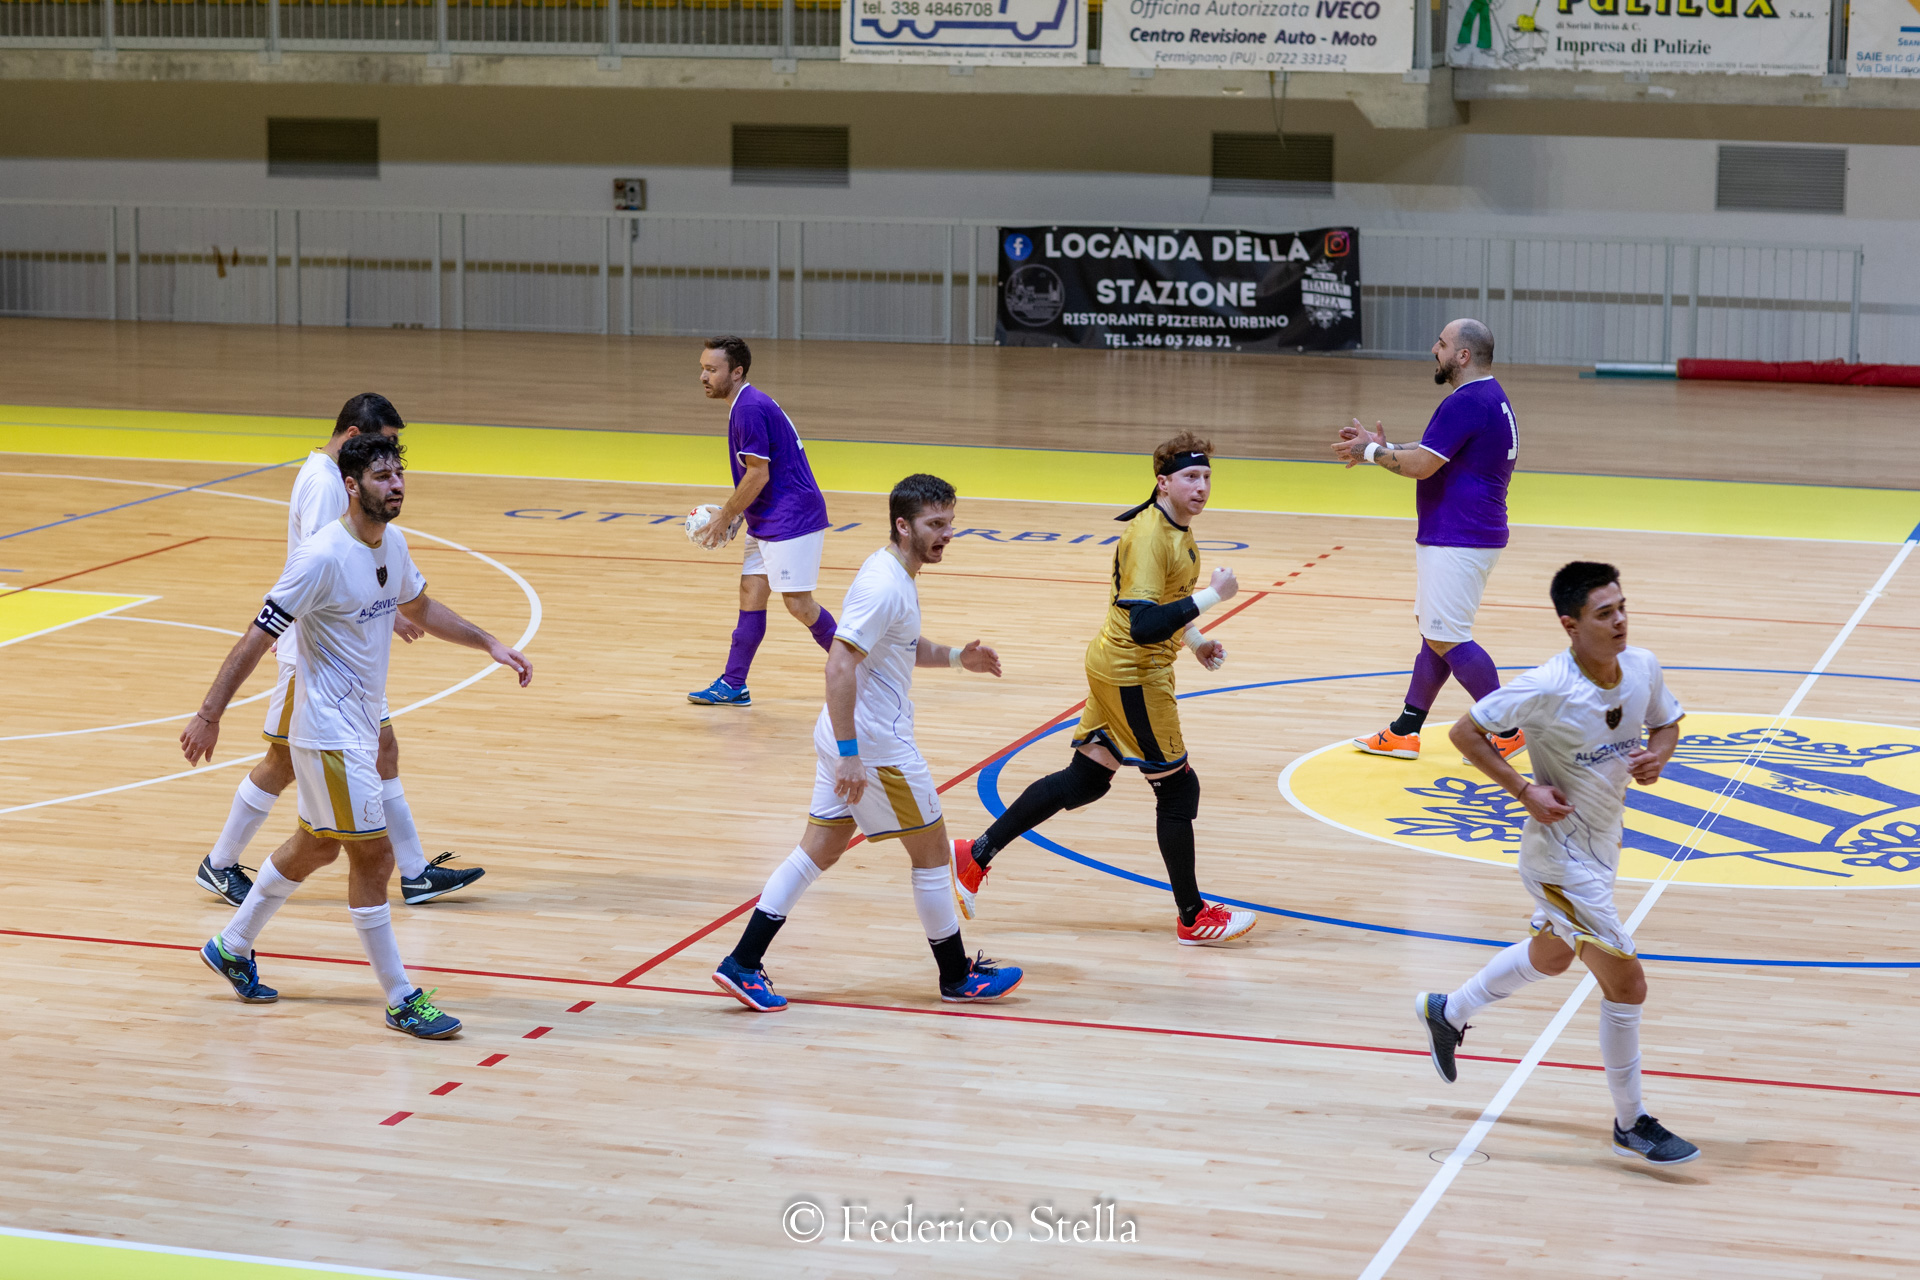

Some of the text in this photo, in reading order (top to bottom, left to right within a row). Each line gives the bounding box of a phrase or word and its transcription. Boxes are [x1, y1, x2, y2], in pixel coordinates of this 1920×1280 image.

[863, 1, 993, 16] tel. 338 4846708
[1130, 0, 1381, 19] Officina Autorizzata IVECO
[1556, 22, 1565, 30] di
[1621, 22, 1629, 31] &
[1130, 27, 1185, 42] Centro
[1189, 28, 1267, 44] Revisione
[1274, 29, 1316, 45] Auto
[1331, 30, 1378, 46] Moto
[1556, 36, 1712, 56] Impresa di Pulizie
[1154, 50, 1227, 65] Fermignano
[1230, 51, 1257, 65] (PU)
[1266, 52, 1298, 65] 0722
[1300, 53, 1347, 65] 331342
[1856, 51, 1883, 61] SAIE
[1885, 54, 1904, 62] snc
[1856, 63, 1872, 73] Via
[1875, 63, 1892, 73] Del
[1045, 232, 1311, 262] LOCANDA DELLA
[1096, 278, 1257, 307] STAZIONE
[1308, 279, 1344, 296] ITALIAN
[1313, 292, 1341, 310] PIZZA
[1063, 312, 1289, 329] RISTORANTE PIZZERIA URBINO
[1104, 333, 1129, 346] TEL
[1165, 333, 1183, 347] 03
[1186, 334, 1213, 347] 788
[1215, 334, 1232, 348] 71
[504, 508, 687, 525] CITT
[257, 604, 273, 625] C
